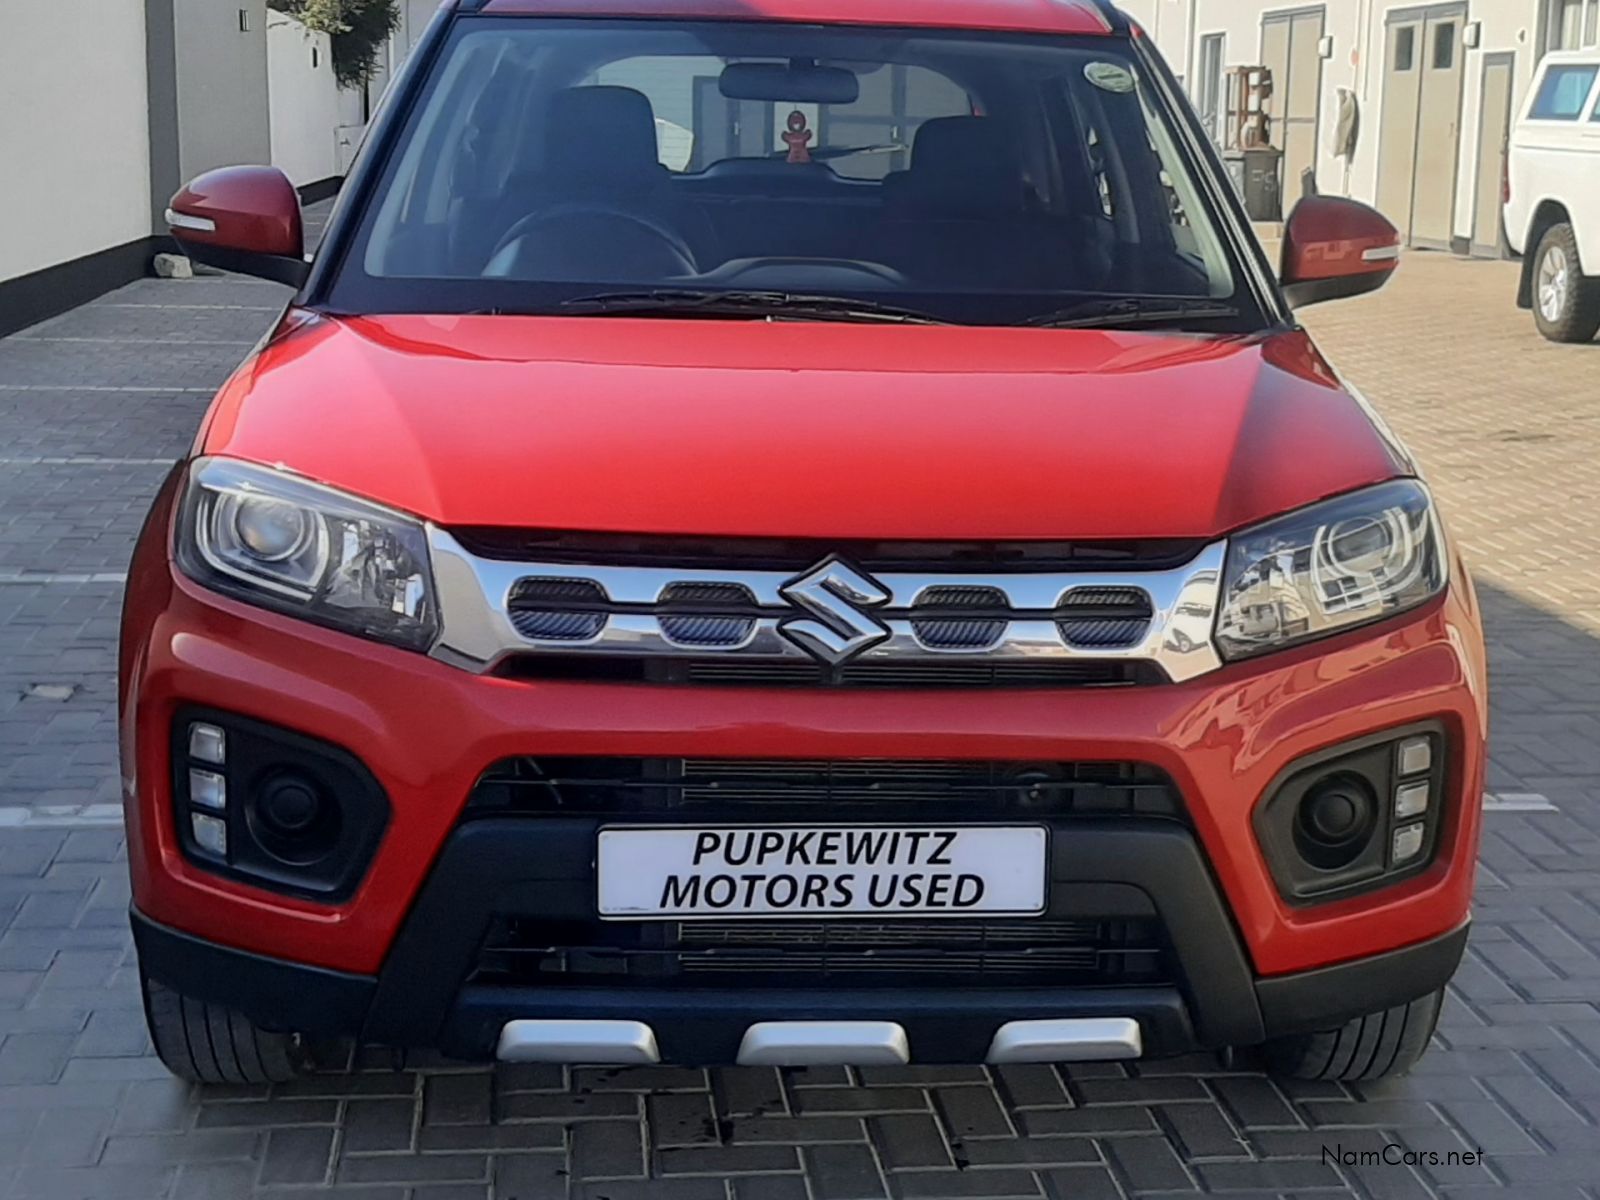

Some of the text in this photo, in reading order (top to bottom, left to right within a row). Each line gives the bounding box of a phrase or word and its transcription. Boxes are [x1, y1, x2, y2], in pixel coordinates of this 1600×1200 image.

[693, 831, 958, 866] PUPKEWITZ
[660, 873, 985, 909] MOTORS USED
